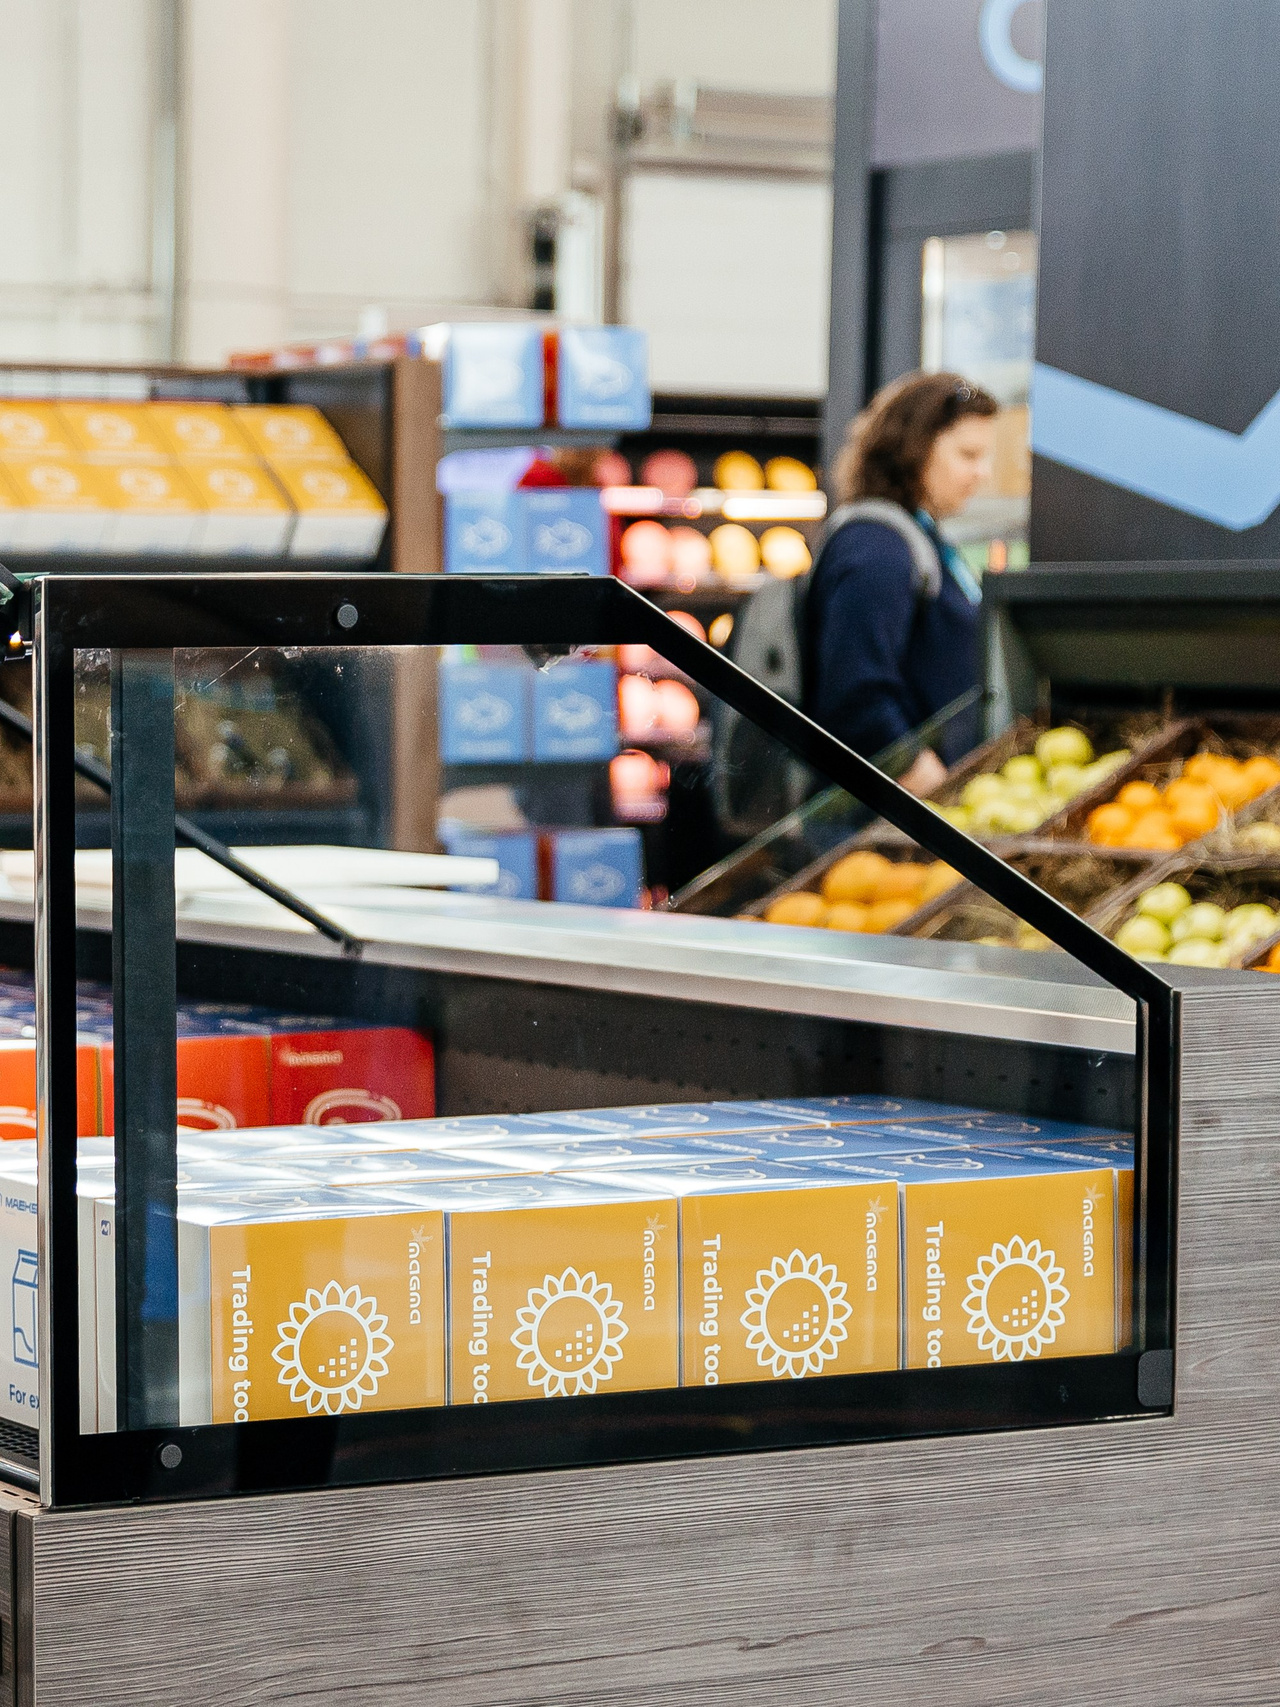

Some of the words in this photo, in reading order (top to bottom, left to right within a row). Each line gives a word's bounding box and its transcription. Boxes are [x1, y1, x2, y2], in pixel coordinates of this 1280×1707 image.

[228, 1265, 254, 1372] Trading
[469, 1251, 493, 1355] Trading
[700, 1234, 724, 1336] Trading
[923, 1221, 946, 1321] Trading
[9, 1383, 26, 1406] For
